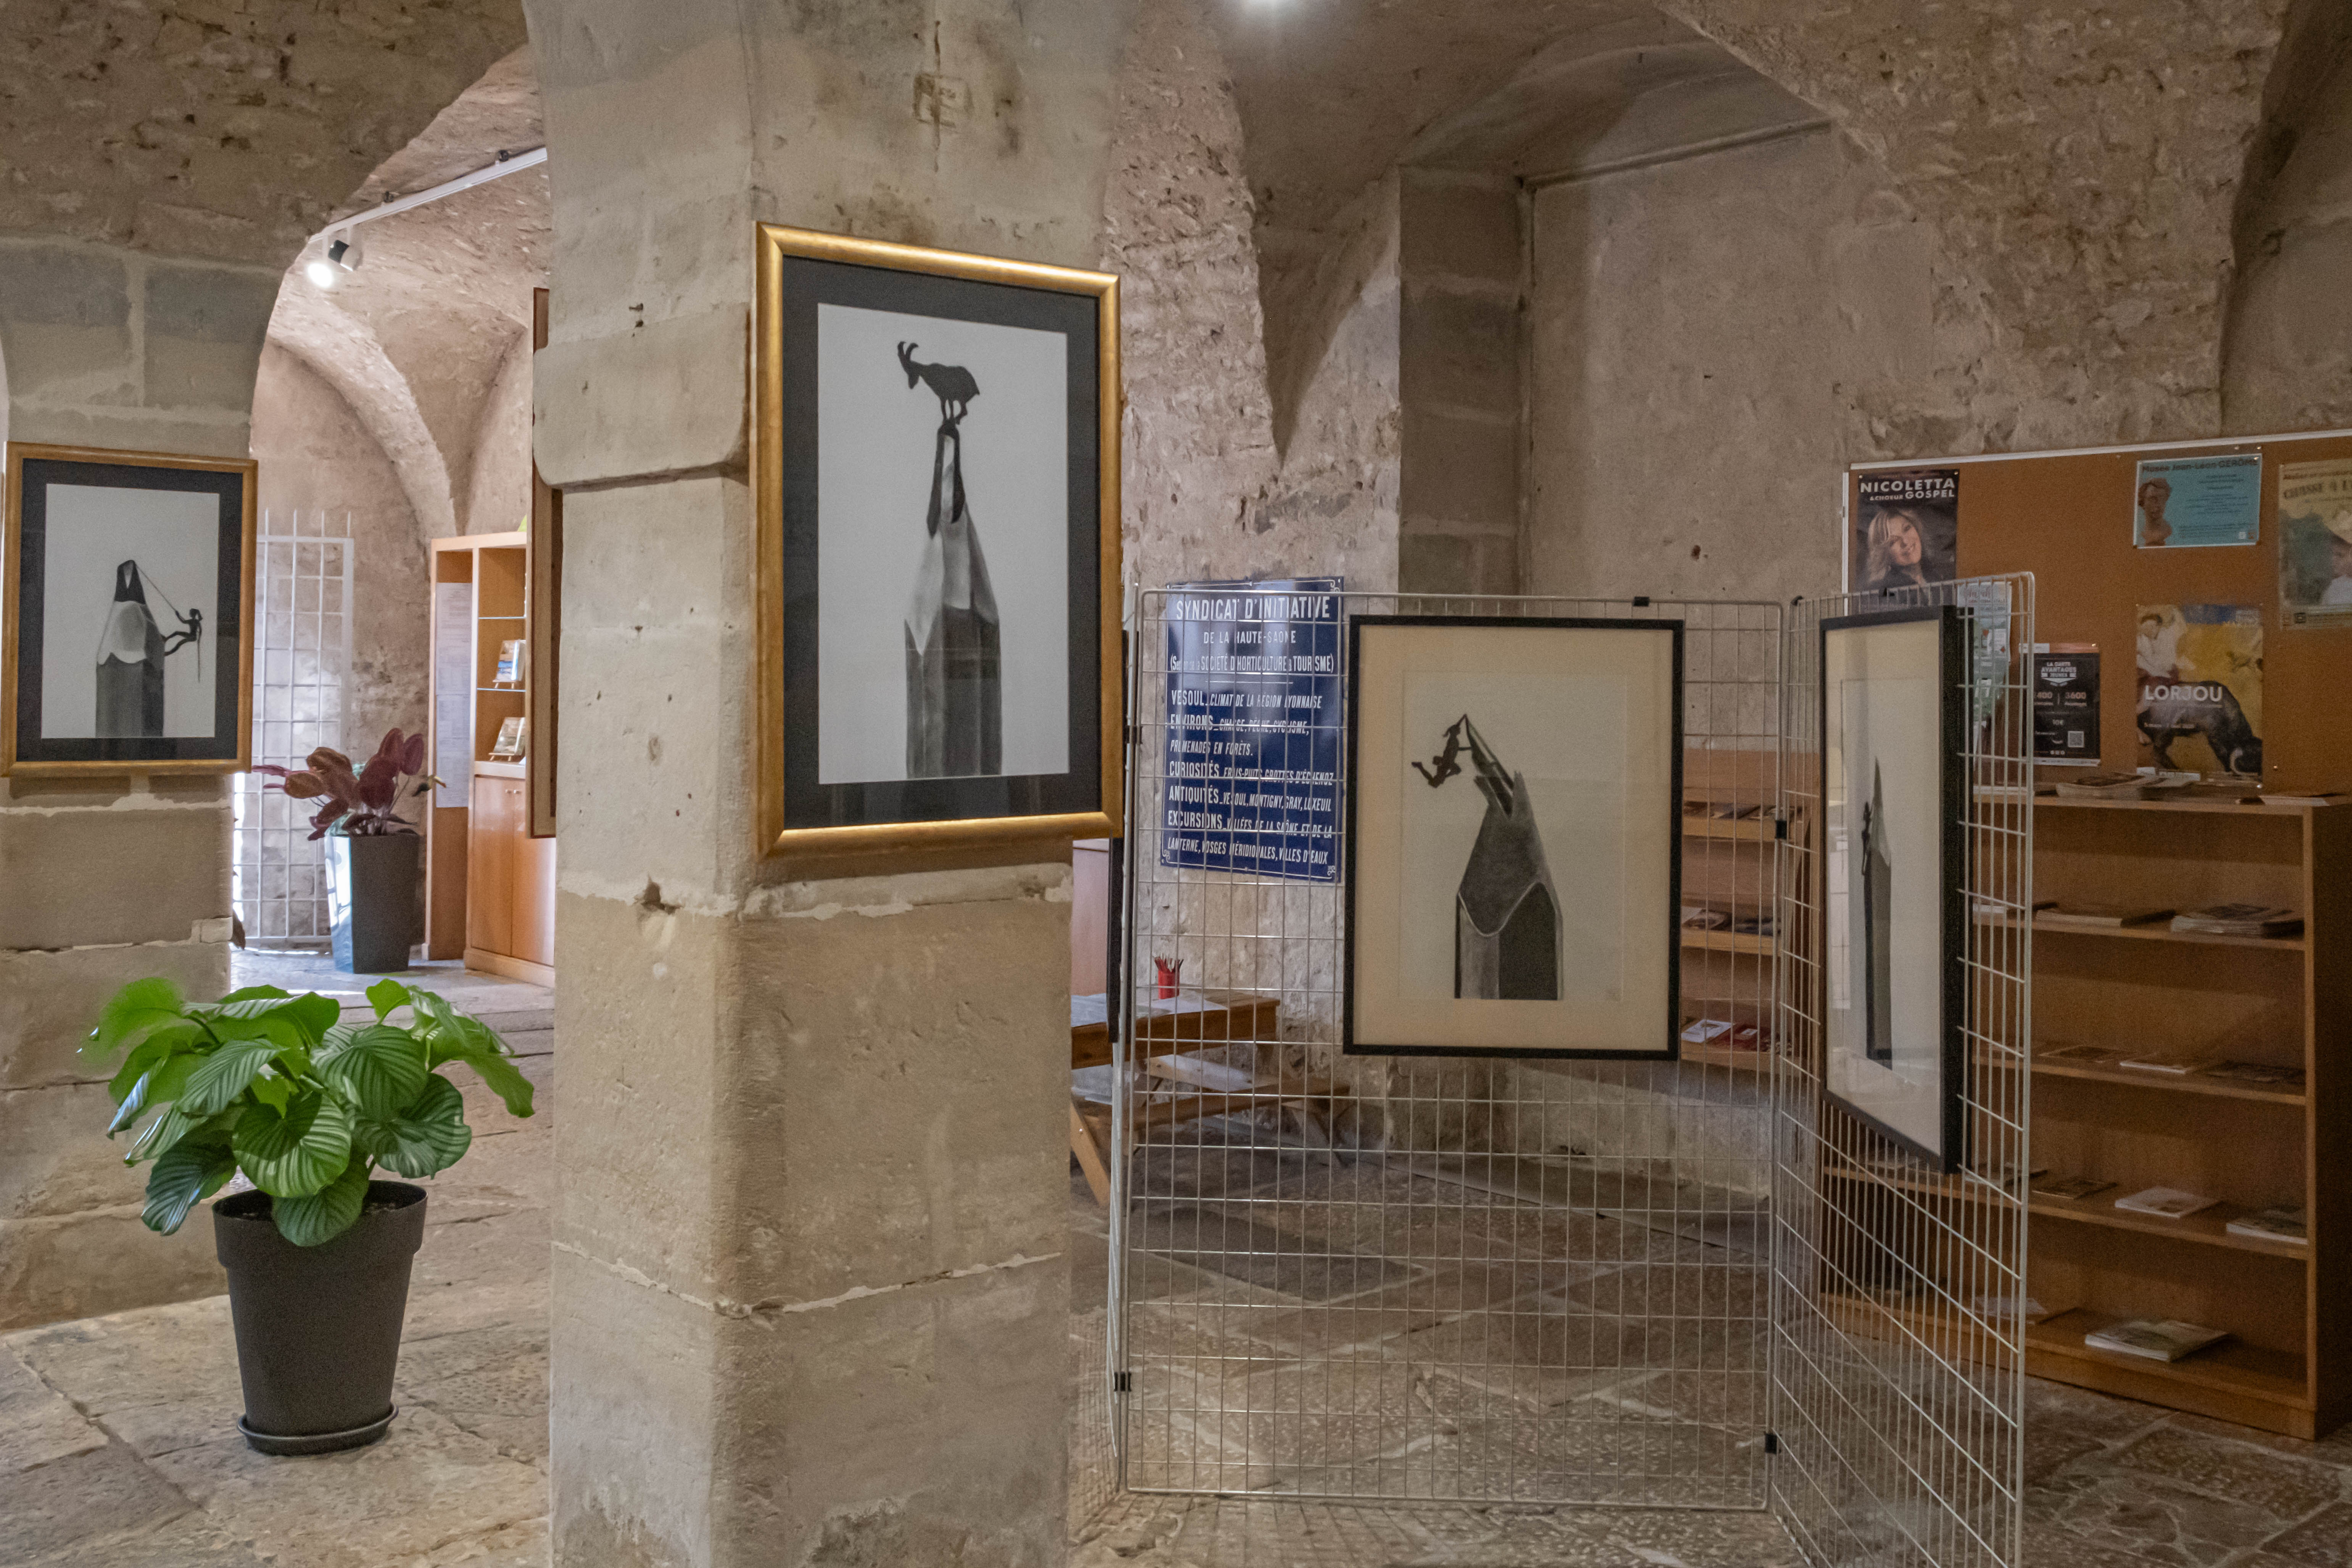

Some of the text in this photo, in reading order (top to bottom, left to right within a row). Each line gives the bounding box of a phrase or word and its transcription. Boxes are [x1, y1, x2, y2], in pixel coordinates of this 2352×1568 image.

[1860, 478, 1955, 493] NICOLETTA
[1905, 489, 1954, 499] GOSPEL
[1176, 596, 1330, 620] SYNDICAT D'INITIATIVE
[1203, 632, 1214, 644] DE
[1219, 632, 1229, 644] LA
[1202, 653, 1228, 671] SOCIÉTÉ
[1293, 653, 1334, 674] TOURSME)
[1210, 693, 1234, 706] CLIMAT
[1236, 694, 1245, 707] DE
[1247, 694, 1253, 707] LA
[1284, 695, 1322, 709] LYONNAISE
[2145, 685, 2223, 702] LORJOU
[1170, 740, 1211, 754] PROMENADES
[1213, 741, 1224, 754] EN
[1170, 760, 1219, 778] CURIOSITÉS
[1304, 797, 1331, 812] LUXEUIL
[1301, 823, 1310, 837] ET
[1312, 824, 1322, 838] DE
[1324, 825, 1332, 839] LA
[1168, 837, 1200, 854] LANTERNE,
